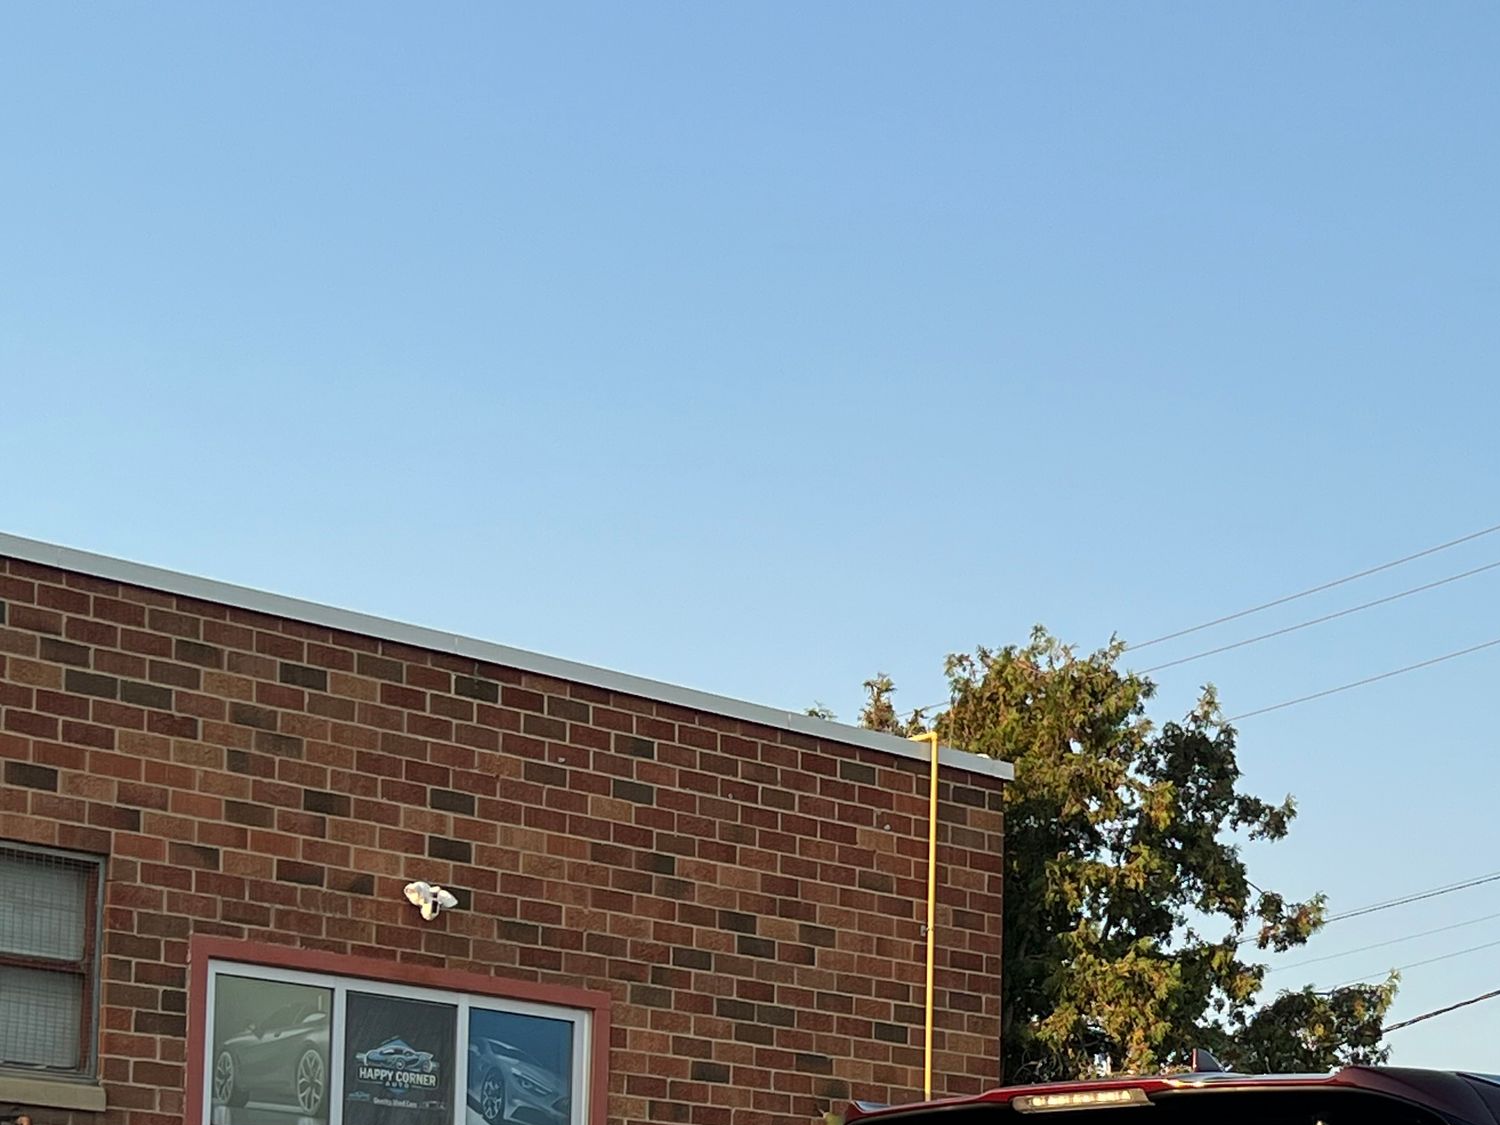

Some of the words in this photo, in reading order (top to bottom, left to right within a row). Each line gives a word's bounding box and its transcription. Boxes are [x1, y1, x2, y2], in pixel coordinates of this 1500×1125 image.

[359, 1067, 394, 1081] HAPPY
[395, 1071, 436, 1087] CORNER
[385, 1081, 410, 1089] AUTO
